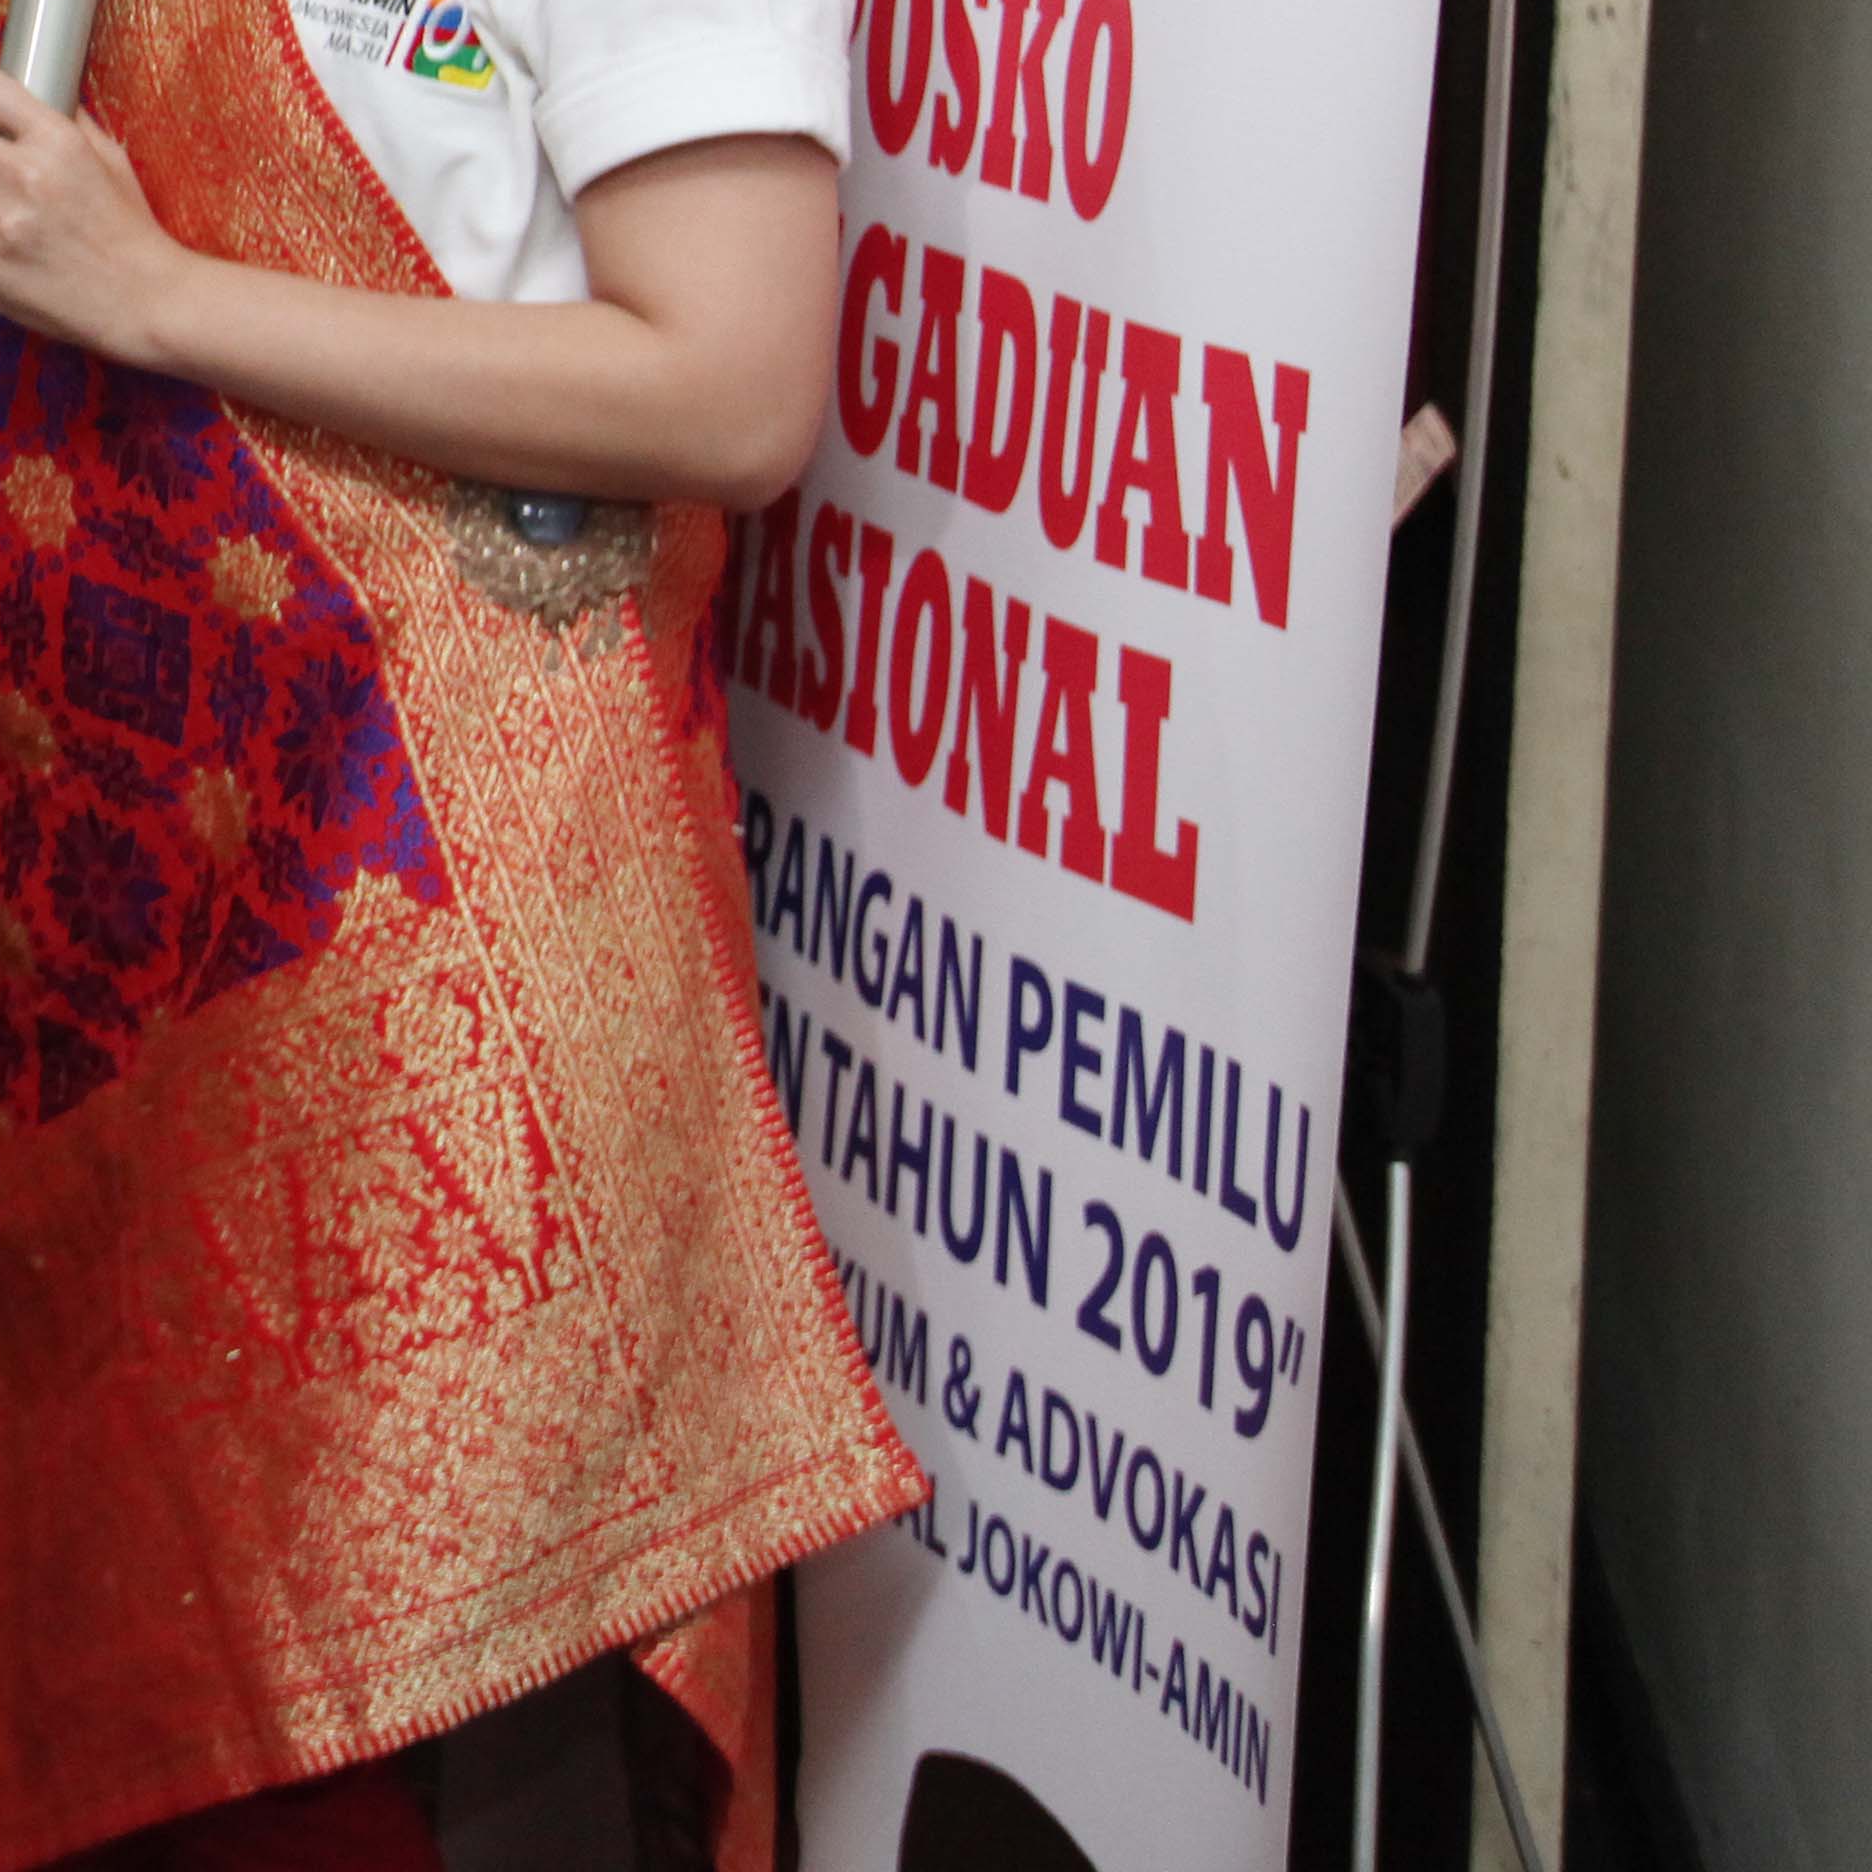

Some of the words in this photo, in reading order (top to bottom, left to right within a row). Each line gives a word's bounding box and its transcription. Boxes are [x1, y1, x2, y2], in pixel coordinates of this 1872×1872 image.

[837, 220, 1311, 632] GADUAN
[743, 813, 983, 1075] RANGAN
[1006, 953, 1312, 1255] PEMILU
[820, 1037, 1056, 1307] TAHUN
[942, 1333, 981, 1441] &
[995, 1369, 1284, 1659] ADVOKASI
[956, 1498, 1271, 1807] JOKOWI-AMIN
